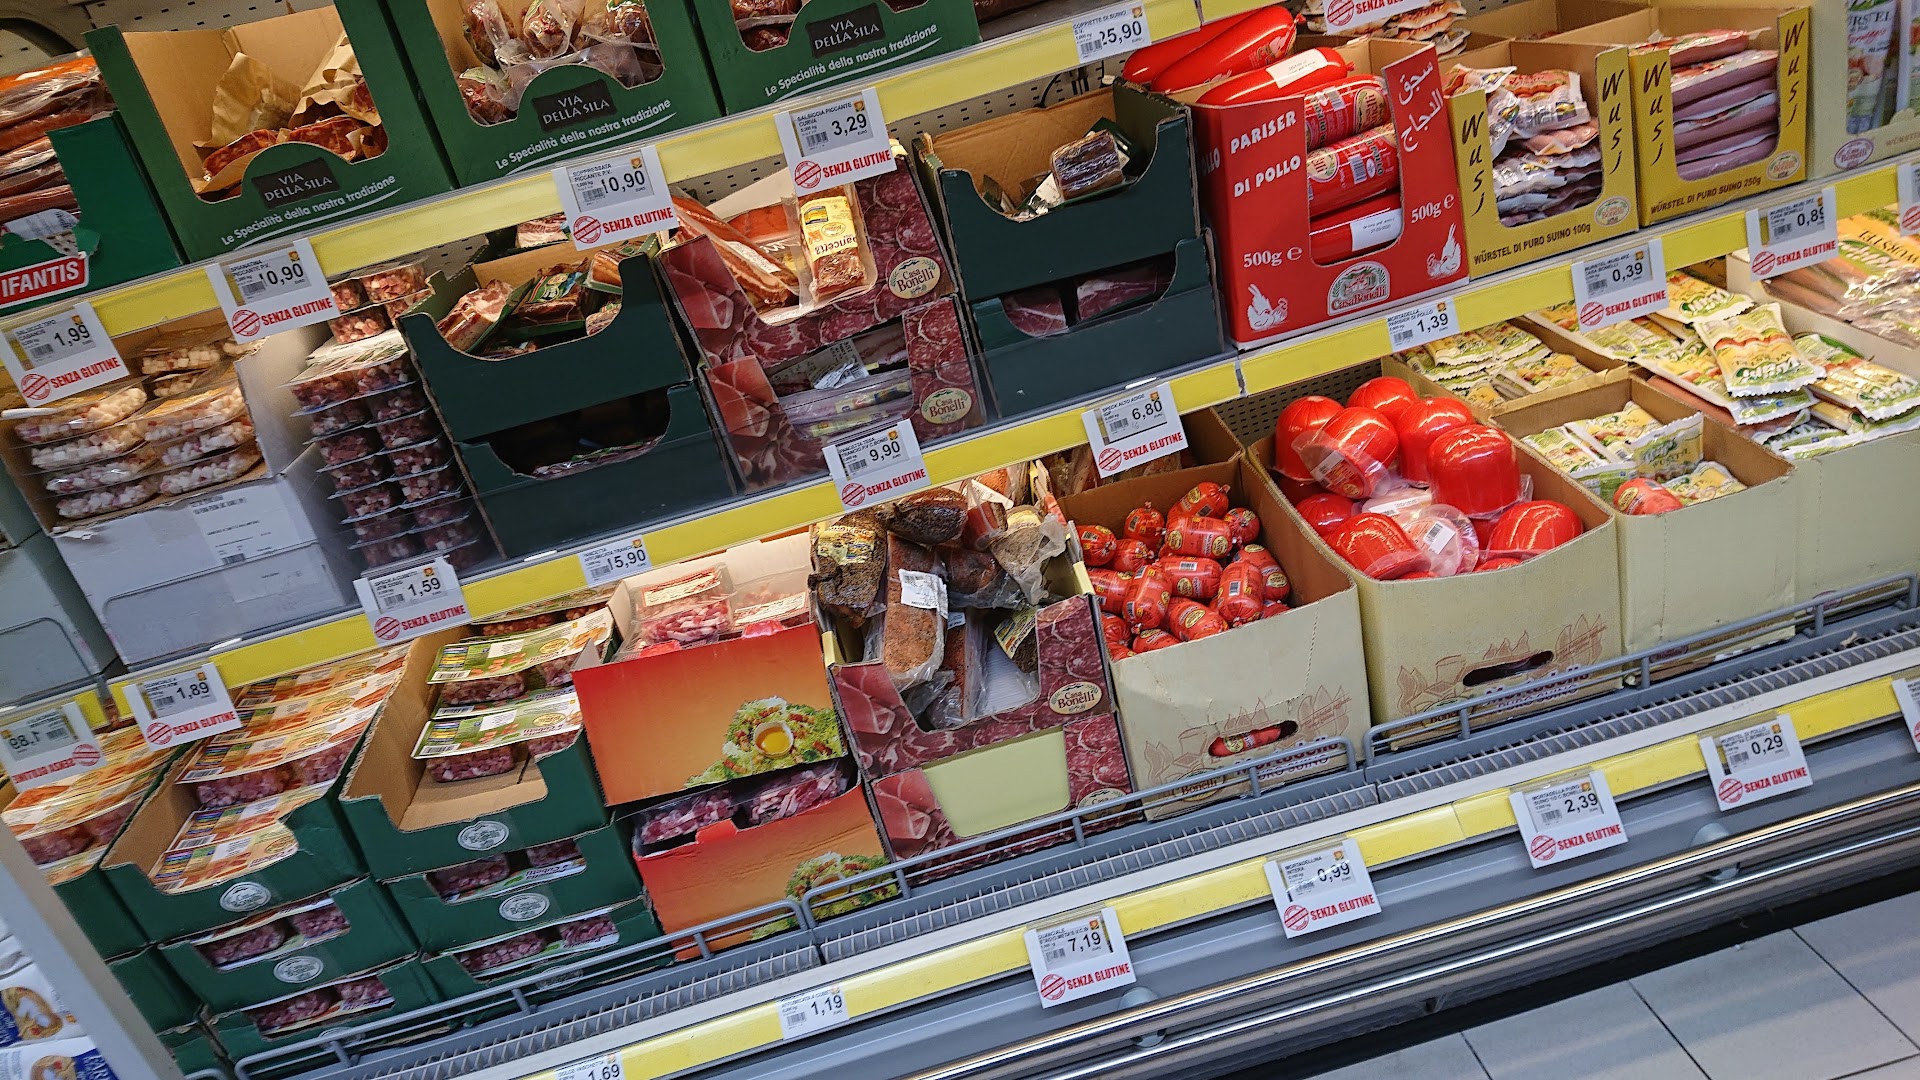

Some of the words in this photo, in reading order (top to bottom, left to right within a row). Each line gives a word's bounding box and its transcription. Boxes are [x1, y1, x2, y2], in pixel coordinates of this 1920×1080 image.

[1355, 0, 1387, 15] SENZA
[814, 31, 852, 50] DELLA
[853, 23, 880, 39] SILA
[830, 19, 855, 33] VIA
[1100, 20, 1142, 46] 25,90
[764, 85, 778, 98] Le
[777, 62, 827, 91] Specialità
[828, 57, 854, 71] della
[856, 46, 888, 64] nostra
[889, 23, 938, 53] tradizione
[542, 107, 582, 125] DELLA
[583, 99, 611, 114] SILA
[558, 94, 583, 108] VIA
[495, 157, 509, 170] Le
[508, 136, 558, 164] Specialità
[559, 130, 587, 145] della
[587, 120, 622, 138] nostra
[622, 98, 672, 127] tradizione
[831, 113, 868, 137] 3,29
[1230, 110, 1297, 155] PARISER
[822, 160, 854, 179] SENZA
[852, 149, 892, 170] GLUTINE
[1233, 179, 1250, 198] DI
[1255, 155, 1301, 188] POLLO
[263, 184, 305, 202] DELLA
[304, 176, 333, 191] SILA
[278, 173, 304, 186] VIA
[601, 170, 645, 194] 10,90
[1650, 196, 1686, 215] WÜRSTEL
[1686, 191, 1696, 204] DI
[1696, 185, 1718, 201] PURO
[1718, 179, 1743, 195] SUINO
[1743, 175, 1762, 190] 250g
[220, 234, 235, 246] Le
[233, 213, 283, 239] Specialità
[284, 206, 311, 221] della
[311, 196, 346, 213] nostra
[346, 174, 396, 202] tradizione
[602, 217, 633, 234] SENZA
[632, 207, 674, 226] GLUTINE
[1411, 198, 1442, 224] 500g
[1473, 247, 1512, 265] WÜRSTEL
[1513, 240, 1523, 252] DI
[1523, 233, 1546, 250] PURO
[1546, 226, 1572, 244] SUINO
[1572, 222, 1592, 239] 100g
[1776, 250, 1802, 266] SENZA
[1803, 239, 1837, 258] GLUTINE
[1243, 247, 1284, 269] 500g
[1, 261, 80, 298] IFANTIS
[259, 263, 304, 288] 10,90
[896, 268, 935, 293] Bonelli
[902, 267, 921, 281] Casa
[1612, 262, 1643, 282] 0,39
[261, 308, 293, 326] SENZA
[292, 297, 333, 317] GLUTINE
[1604, 301, 1631, 316] SENZA
[1632, 290, 1666, 308] GLUTINE
[54, 324, 91, 347] 1,99
[1417, 312, 1449, 334] 1,39
[50, 371, 82, 388] SENZA
[79, 357, 121, 379] GLUTINE
[929, 396, 966, 419] Bonelli
[935, 397, 953, 409] Casa
[1132, 400, 1163, 420] 6,80
[869, 441, 901, 461] 9,90
[1122, 444, 1149, 461] SENZA
[1149, 431, 1183, 451] GLUTINE
[866, 480, 893, 496] SENZA
[892, 468, 926, 487] GLUTINE
[607, 549, 646, 571] 15,90
[408, 577, 441, 597] 1,59
[401, 616, 430, 630] SENZA
[429, 605, 466, 622] GLUTINE
[176, 682, 210, 701] 1,89
[1057, 691, 1096, 710] Bonelli
[1064, 690, 1082, 701] Casa
[172, 721, 200, 736] SENZA
[200, 711, 237, 728] GLUTINE
[1751, 735, 1783, 755] 0,29
[1744, 778, 1771, 793] SENZA
[1771, 767, 1808, 785] GLUTINE
[1564, 792, 1598, 813] 2,39
[1557, 835, 1585, 851] SENZA
[1585, 824, 1622, 843] GLUTINE
[1317, 861, 1350, 882] 0,99
[1310, 905, 1338, 921] SENZA
[1338, 894, 1376, 913] GLUTINE
[1068, 932, 1101, 953] 7,19
[1067, 973, 1094, 990] SENZA
[1094, 963, 1130, 982] GLUTINE
[810, 995, 843, 1017] 1,19
[588, 1062, 620, 1080] 1,69
